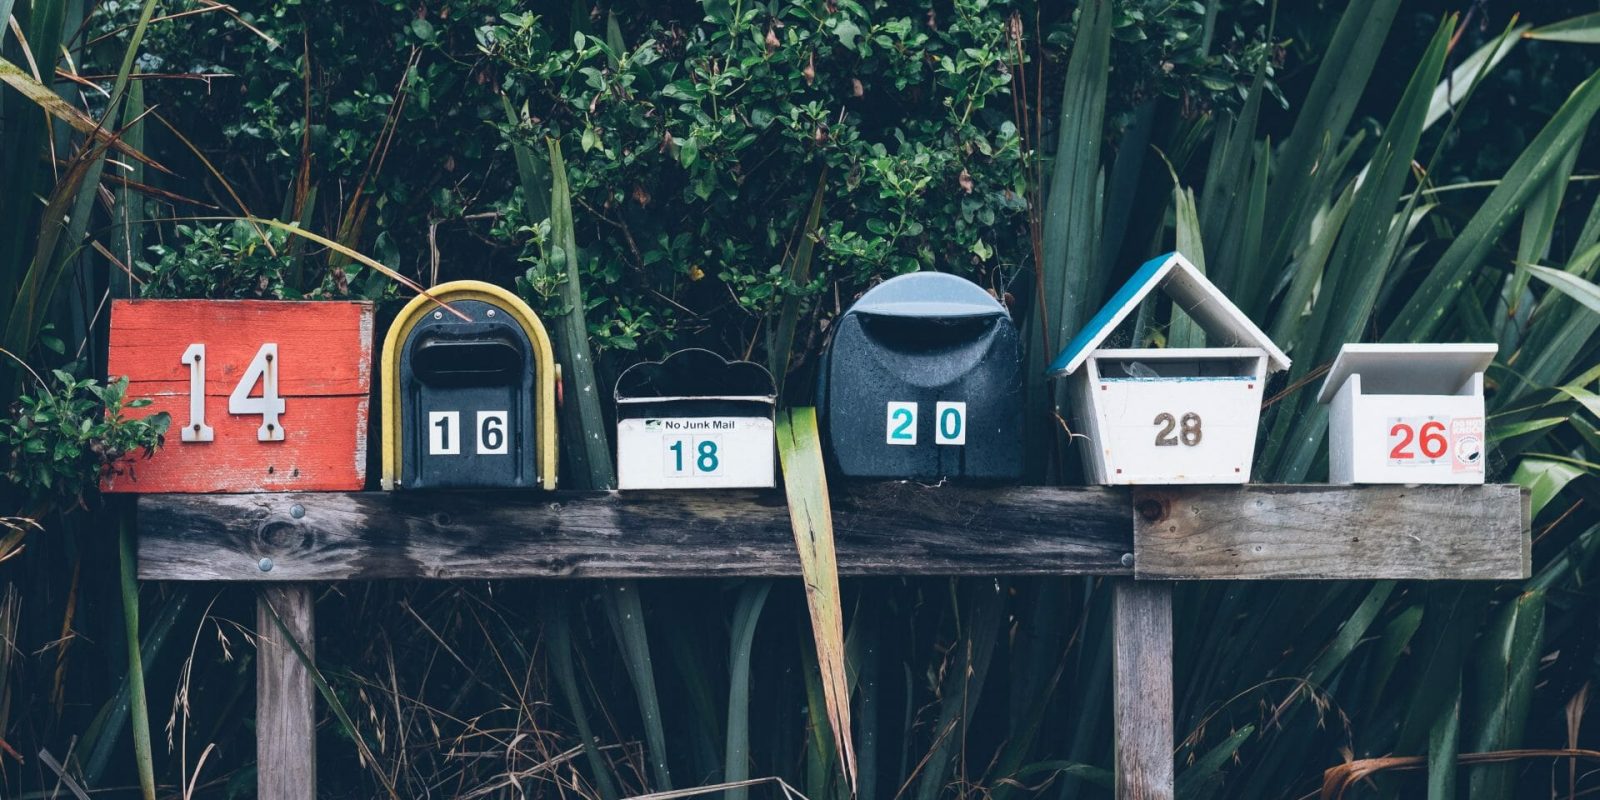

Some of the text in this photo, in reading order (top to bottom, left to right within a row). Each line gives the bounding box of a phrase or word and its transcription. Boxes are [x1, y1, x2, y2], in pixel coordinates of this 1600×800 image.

[181, 343, 285, 442] 14
[434, 416, 504, 450] 16
[665, 420, 735, 430] No Junk Mail
[891, 408, 961, 440] 20
[1153, 412, 1203, 447] 28
[1389, 421, 1448, 459] 26
[670, 440, 719, 472] 18
